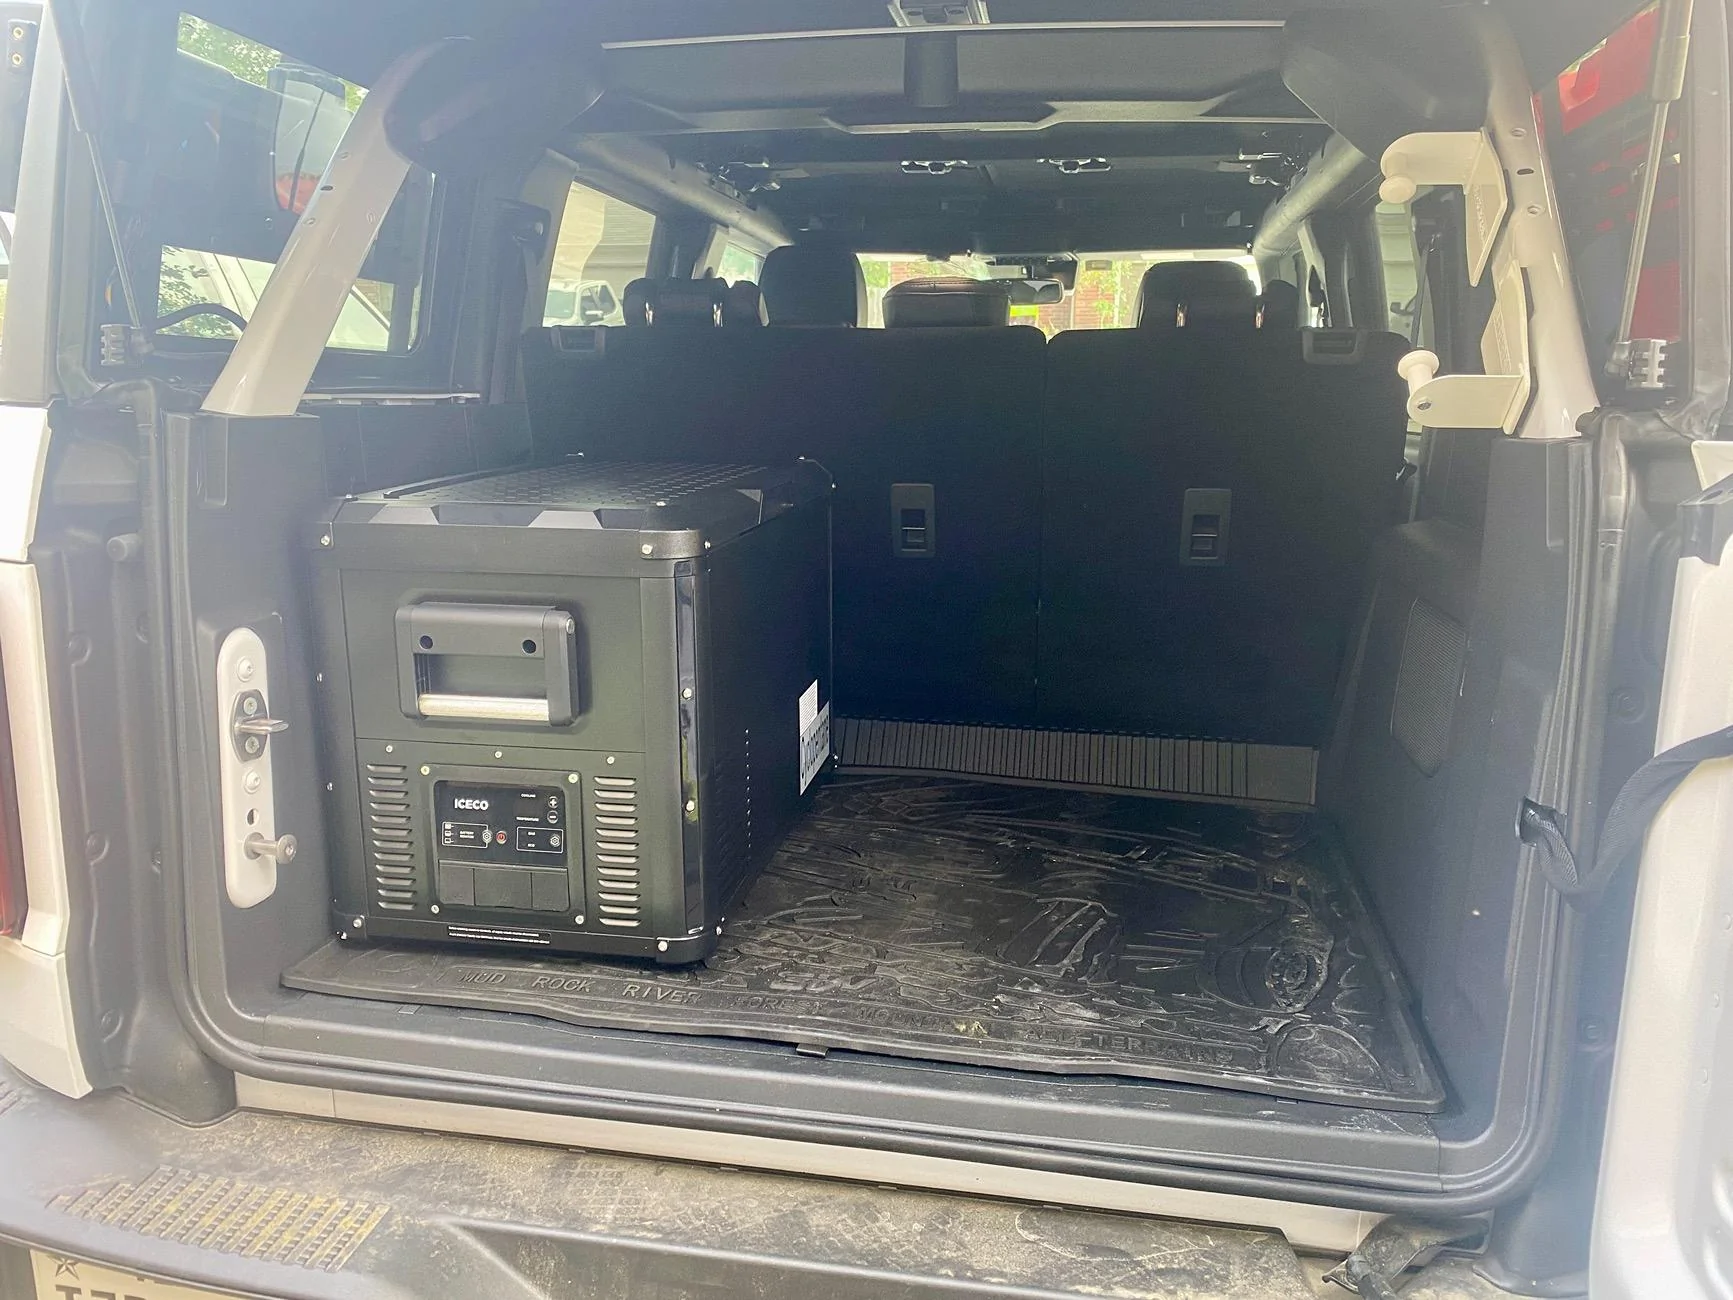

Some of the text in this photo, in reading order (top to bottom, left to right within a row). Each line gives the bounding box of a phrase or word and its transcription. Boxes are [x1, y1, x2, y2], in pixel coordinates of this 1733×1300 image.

[454, 798, 489, 811] ICECO
[460, 970, 507, 985] MUD
[531, 975, 597, 993] ROCK
[621, 983, 702, 1004] RIVER
